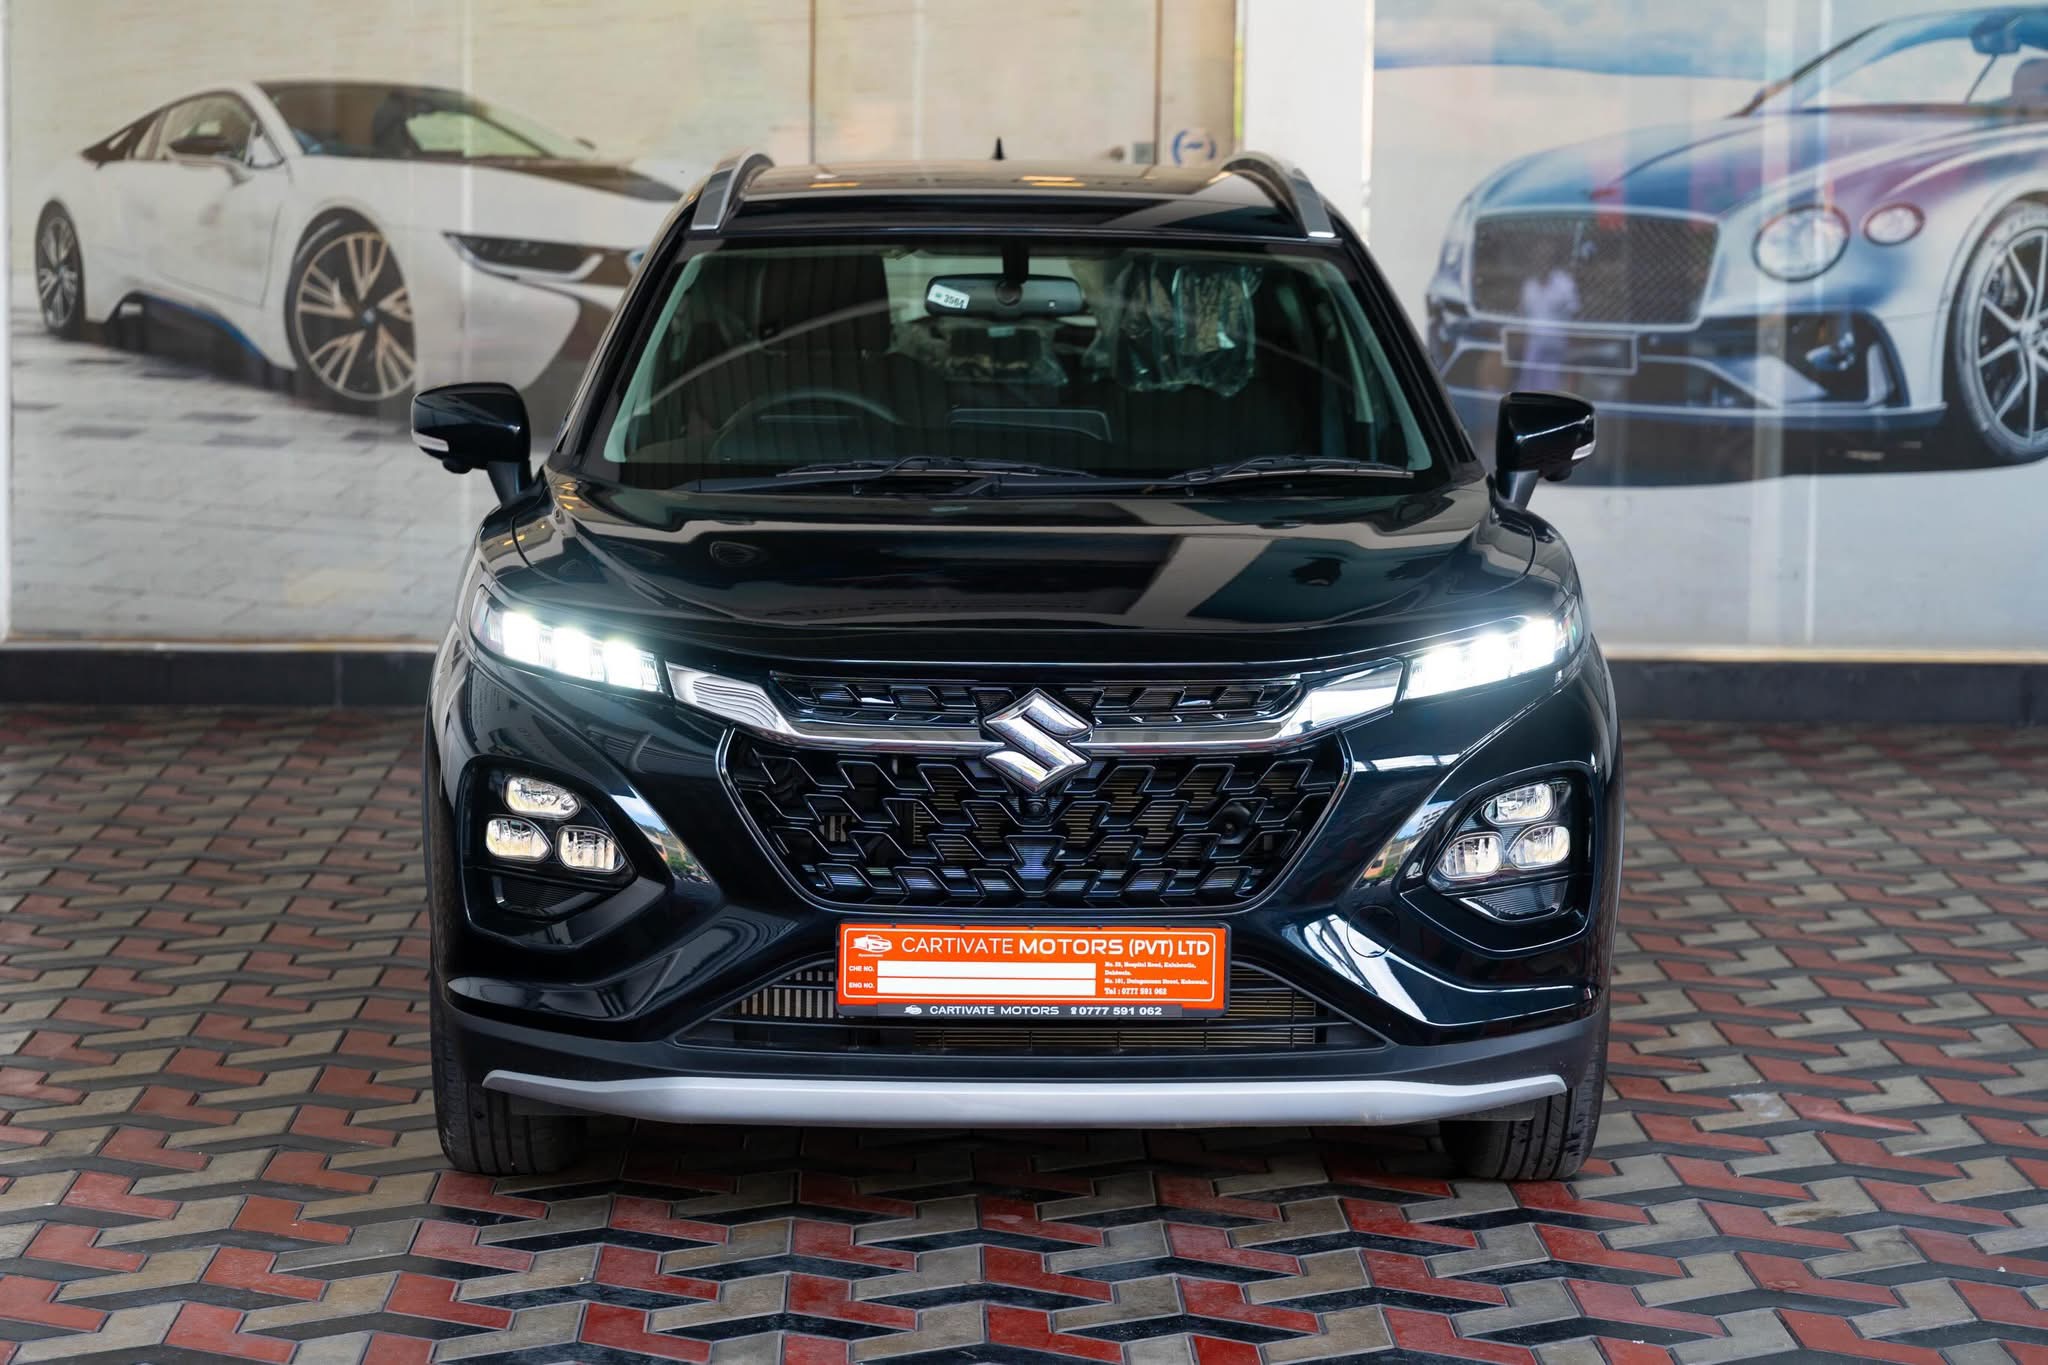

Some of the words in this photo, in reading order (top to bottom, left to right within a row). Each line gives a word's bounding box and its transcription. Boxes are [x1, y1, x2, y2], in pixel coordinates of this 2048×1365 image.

[901, 936, 1014, 954] CARTIVATE
[1019, 937, 1124, 955] MOTORS
[1129, 938, 1174, 958] (PVT)
[1177, 940, 1210, 956] LTD
[929, 1005, 995, 1015] CARTIVATE
[1000, 1006, 1060, 1015] MOTORS
[1079, 1006, 1109, 1016] 0777
[1113, 1006, 1135, 1016] 591
[1139, 1006, 1162, 1016] 062
